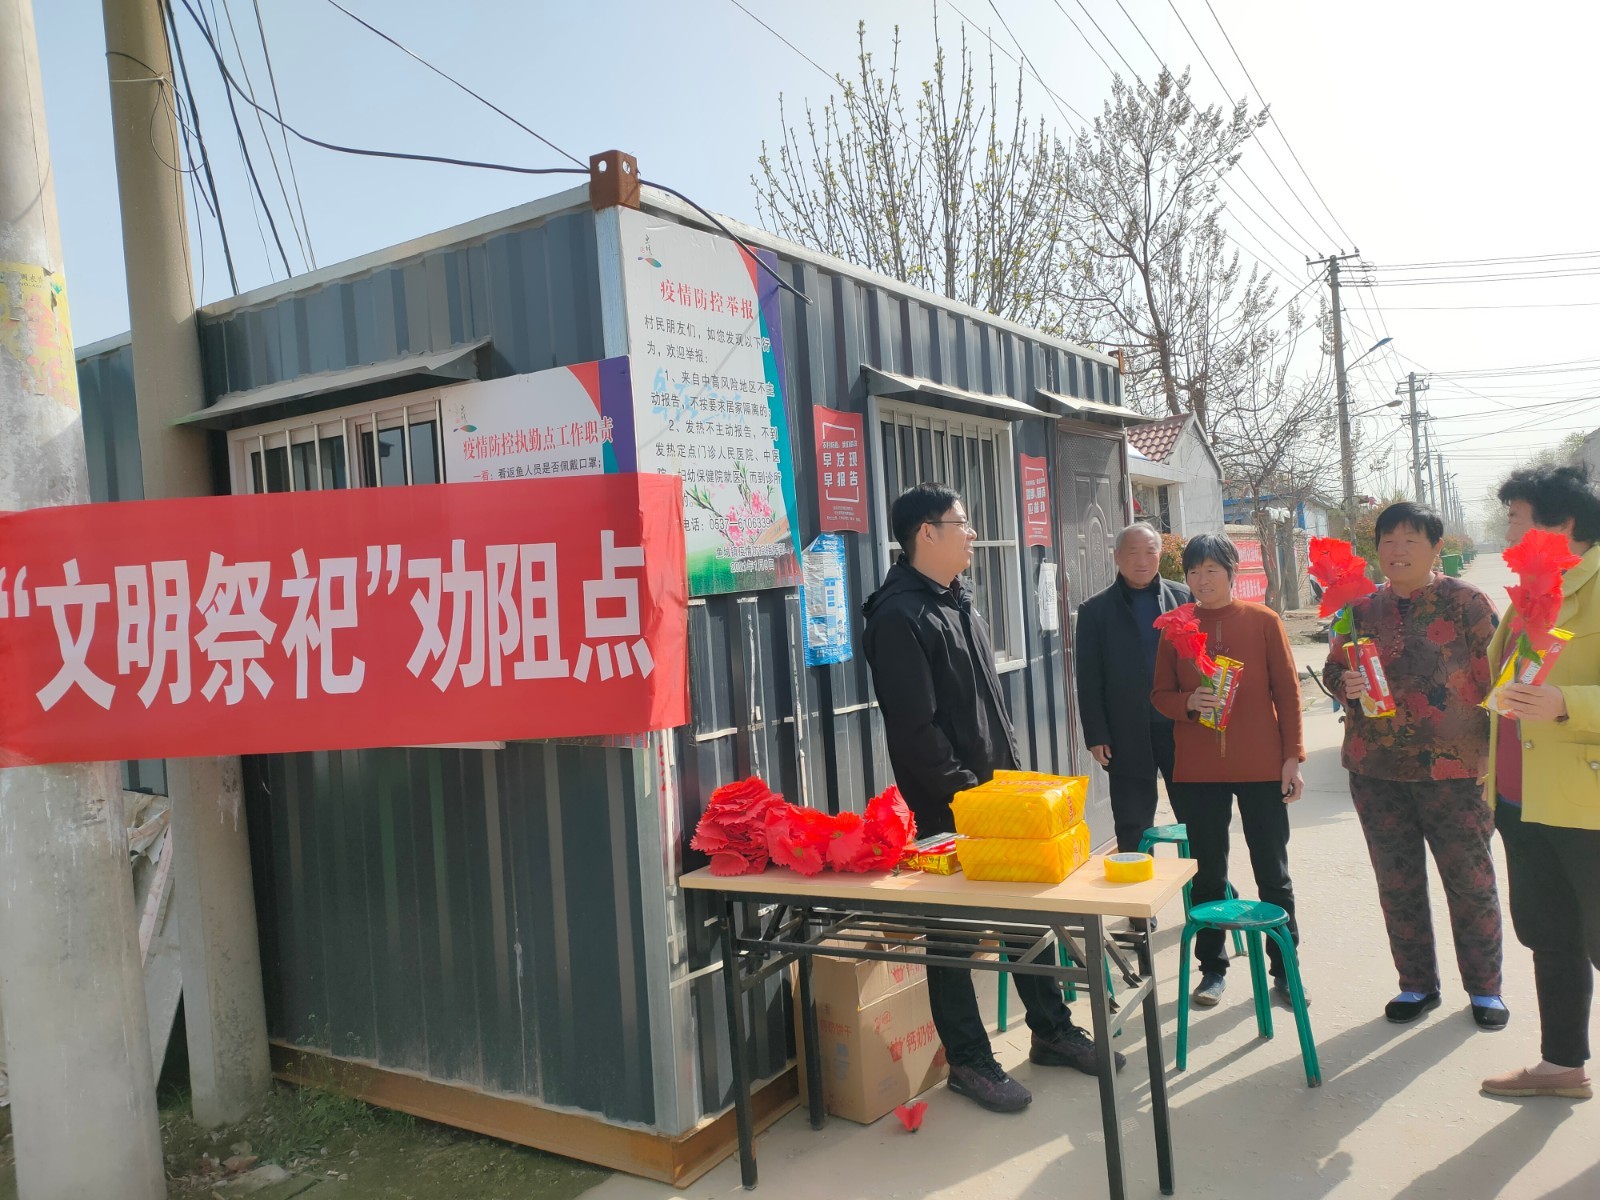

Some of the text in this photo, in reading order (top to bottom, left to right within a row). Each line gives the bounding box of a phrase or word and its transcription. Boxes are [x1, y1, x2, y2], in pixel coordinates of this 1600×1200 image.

[660, 279, 754, 320] 疫情防控举报
[644, 314, 771, 352] 村民朋友们，如您发现以下行
[665, 369, 775, 397] 1、来自中高风险地区不主
[463, 416, 613, 460] 疫情防控执勤点工作职责
[655, 442, 780, 463] 发热定点门诊人民医院、中医
[823, 451, 857, 467] 早发现
[824, 471, 858, 487] 早报告
